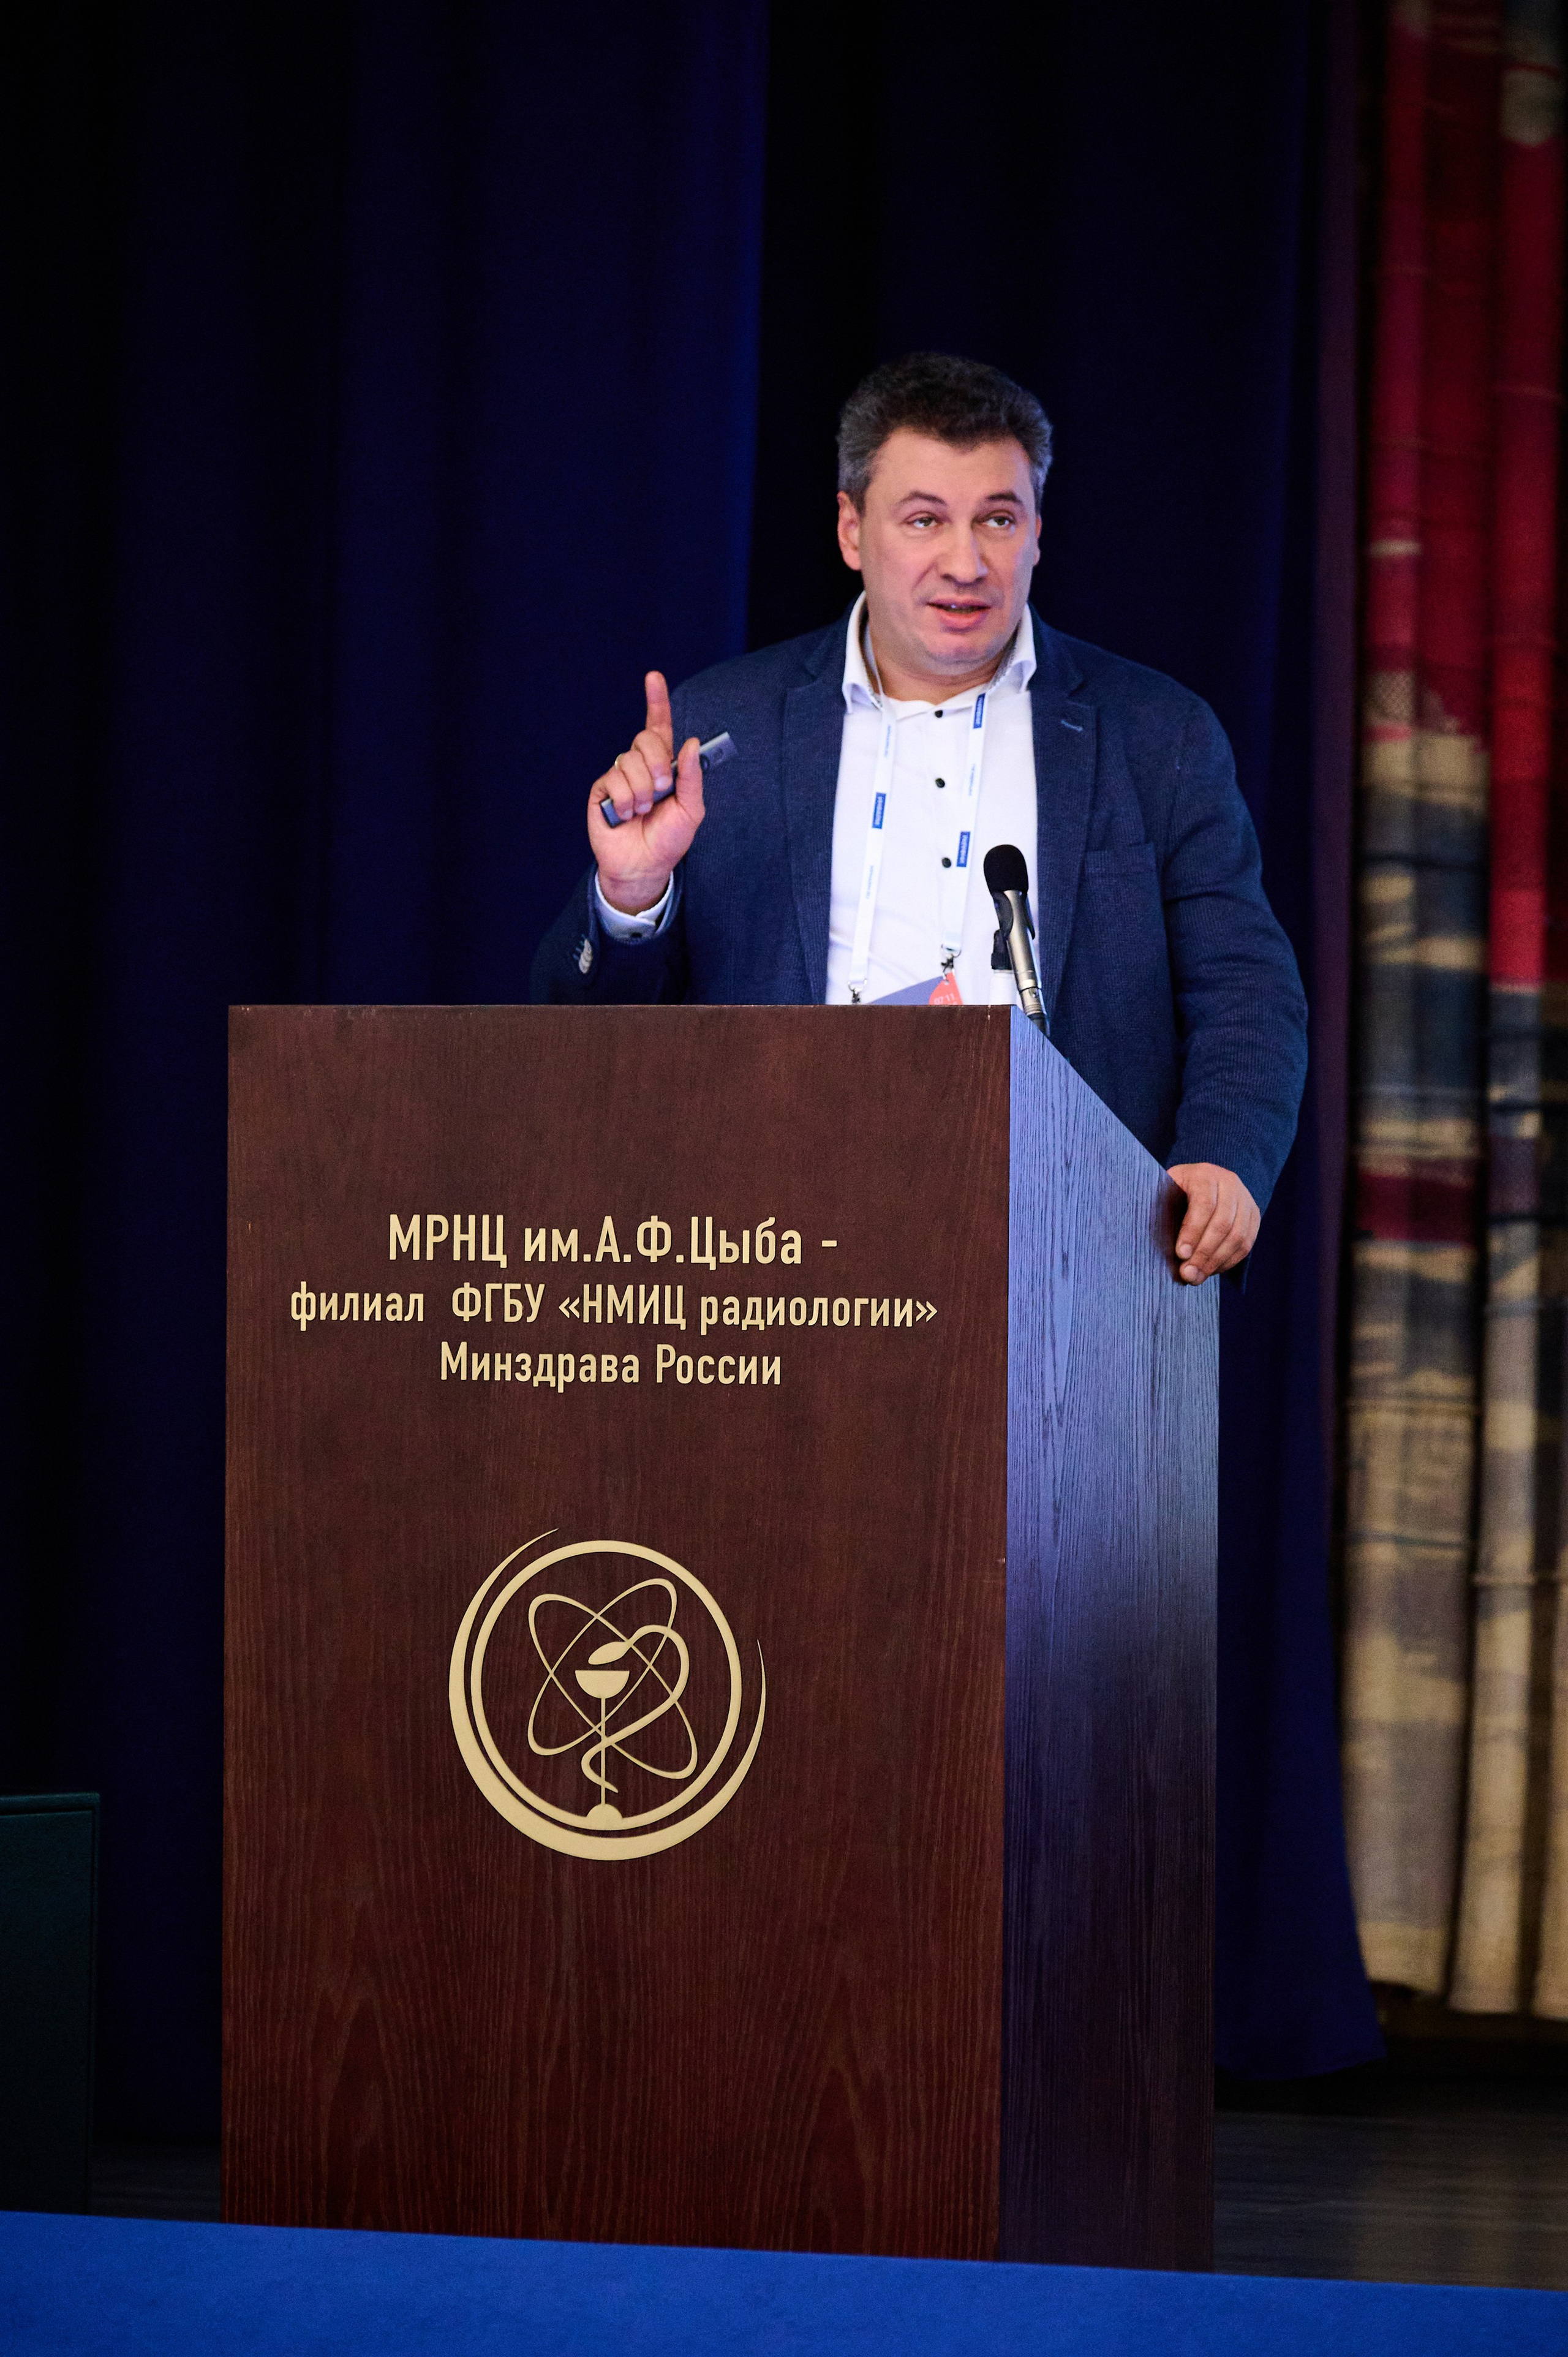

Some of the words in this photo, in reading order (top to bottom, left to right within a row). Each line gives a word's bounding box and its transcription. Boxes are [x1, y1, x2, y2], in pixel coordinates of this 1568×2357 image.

[389, 1213, 507, 1269] МРНЦ
[291, 1281, 424, 1332] филиал
[452, 1282, 545, 1323] ФГБУ
[558, 1283, 687, 1330] «НМИЦ
[700, 1296, 938, 1336] радиологии»
[440, 1341, 639, 1393] Минздрава
[656, 1344, 781, 1385] России
